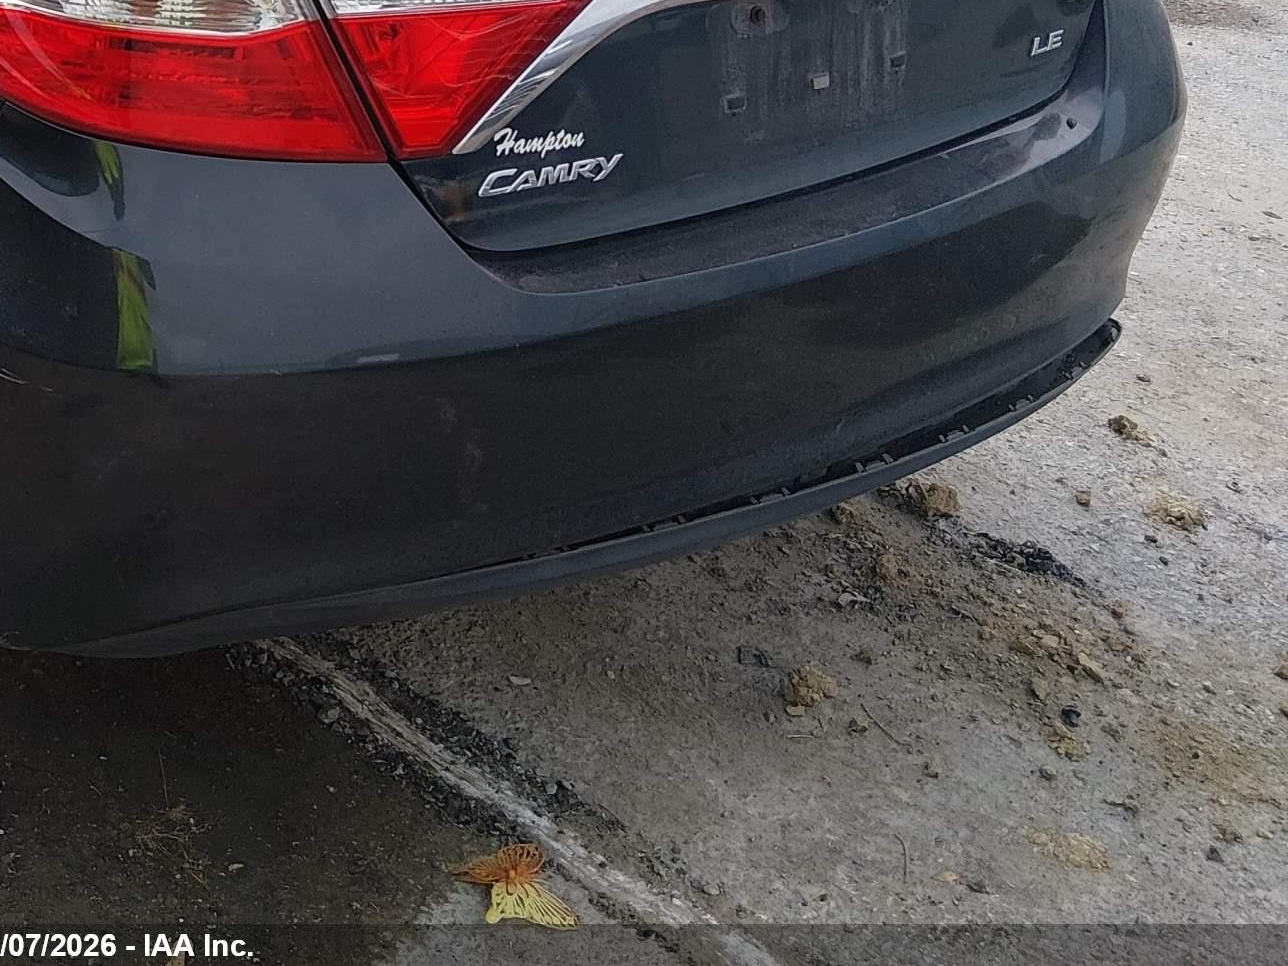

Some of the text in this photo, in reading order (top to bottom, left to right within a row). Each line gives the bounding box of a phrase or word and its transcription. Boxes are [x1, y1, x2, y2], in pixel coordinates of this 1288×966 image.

[1030, 29, 1065, 57] LE
[493, 127, 585, 158] Hampton
[478, 153, 624, 197] CAMRY
